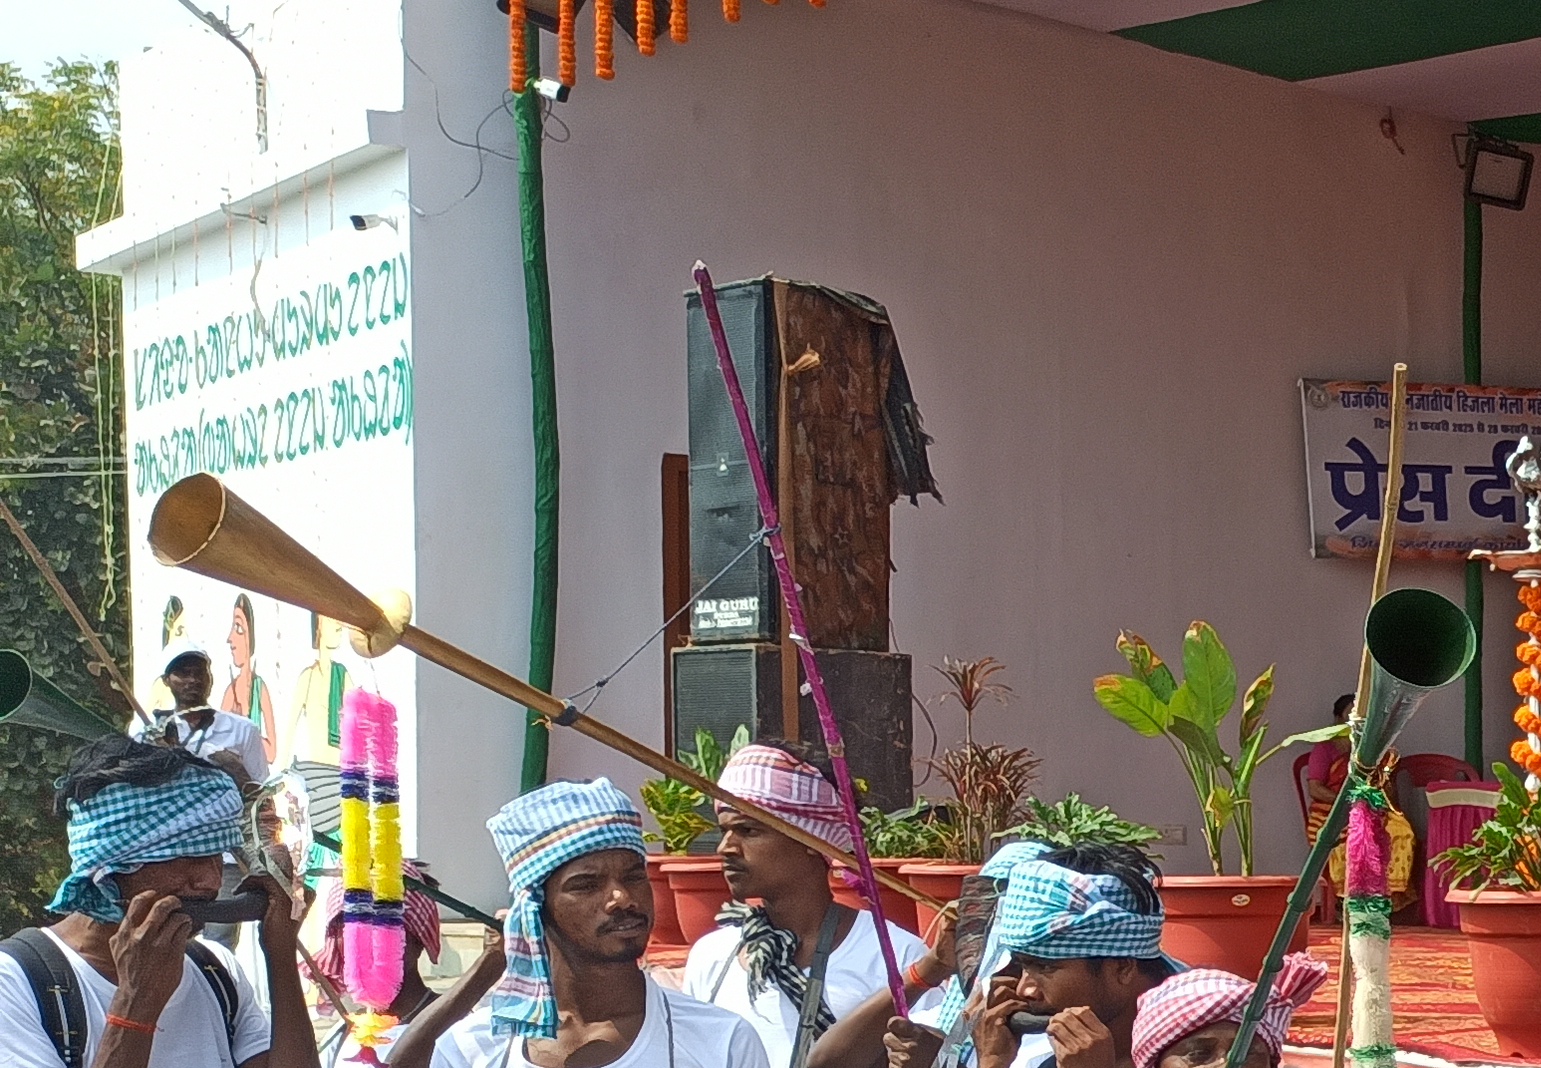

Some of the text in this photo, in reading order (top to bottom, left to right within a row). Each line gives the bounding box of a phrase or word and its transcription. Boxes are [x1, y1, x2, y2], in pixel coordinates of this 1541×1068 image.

[1456, 390, 1496, 415] हिजला
[1499, 390, 1524, 415] मेला
[1324, 437, 1453, 532] प्रेस
[694, 597, 760, 615] JAI GURU
